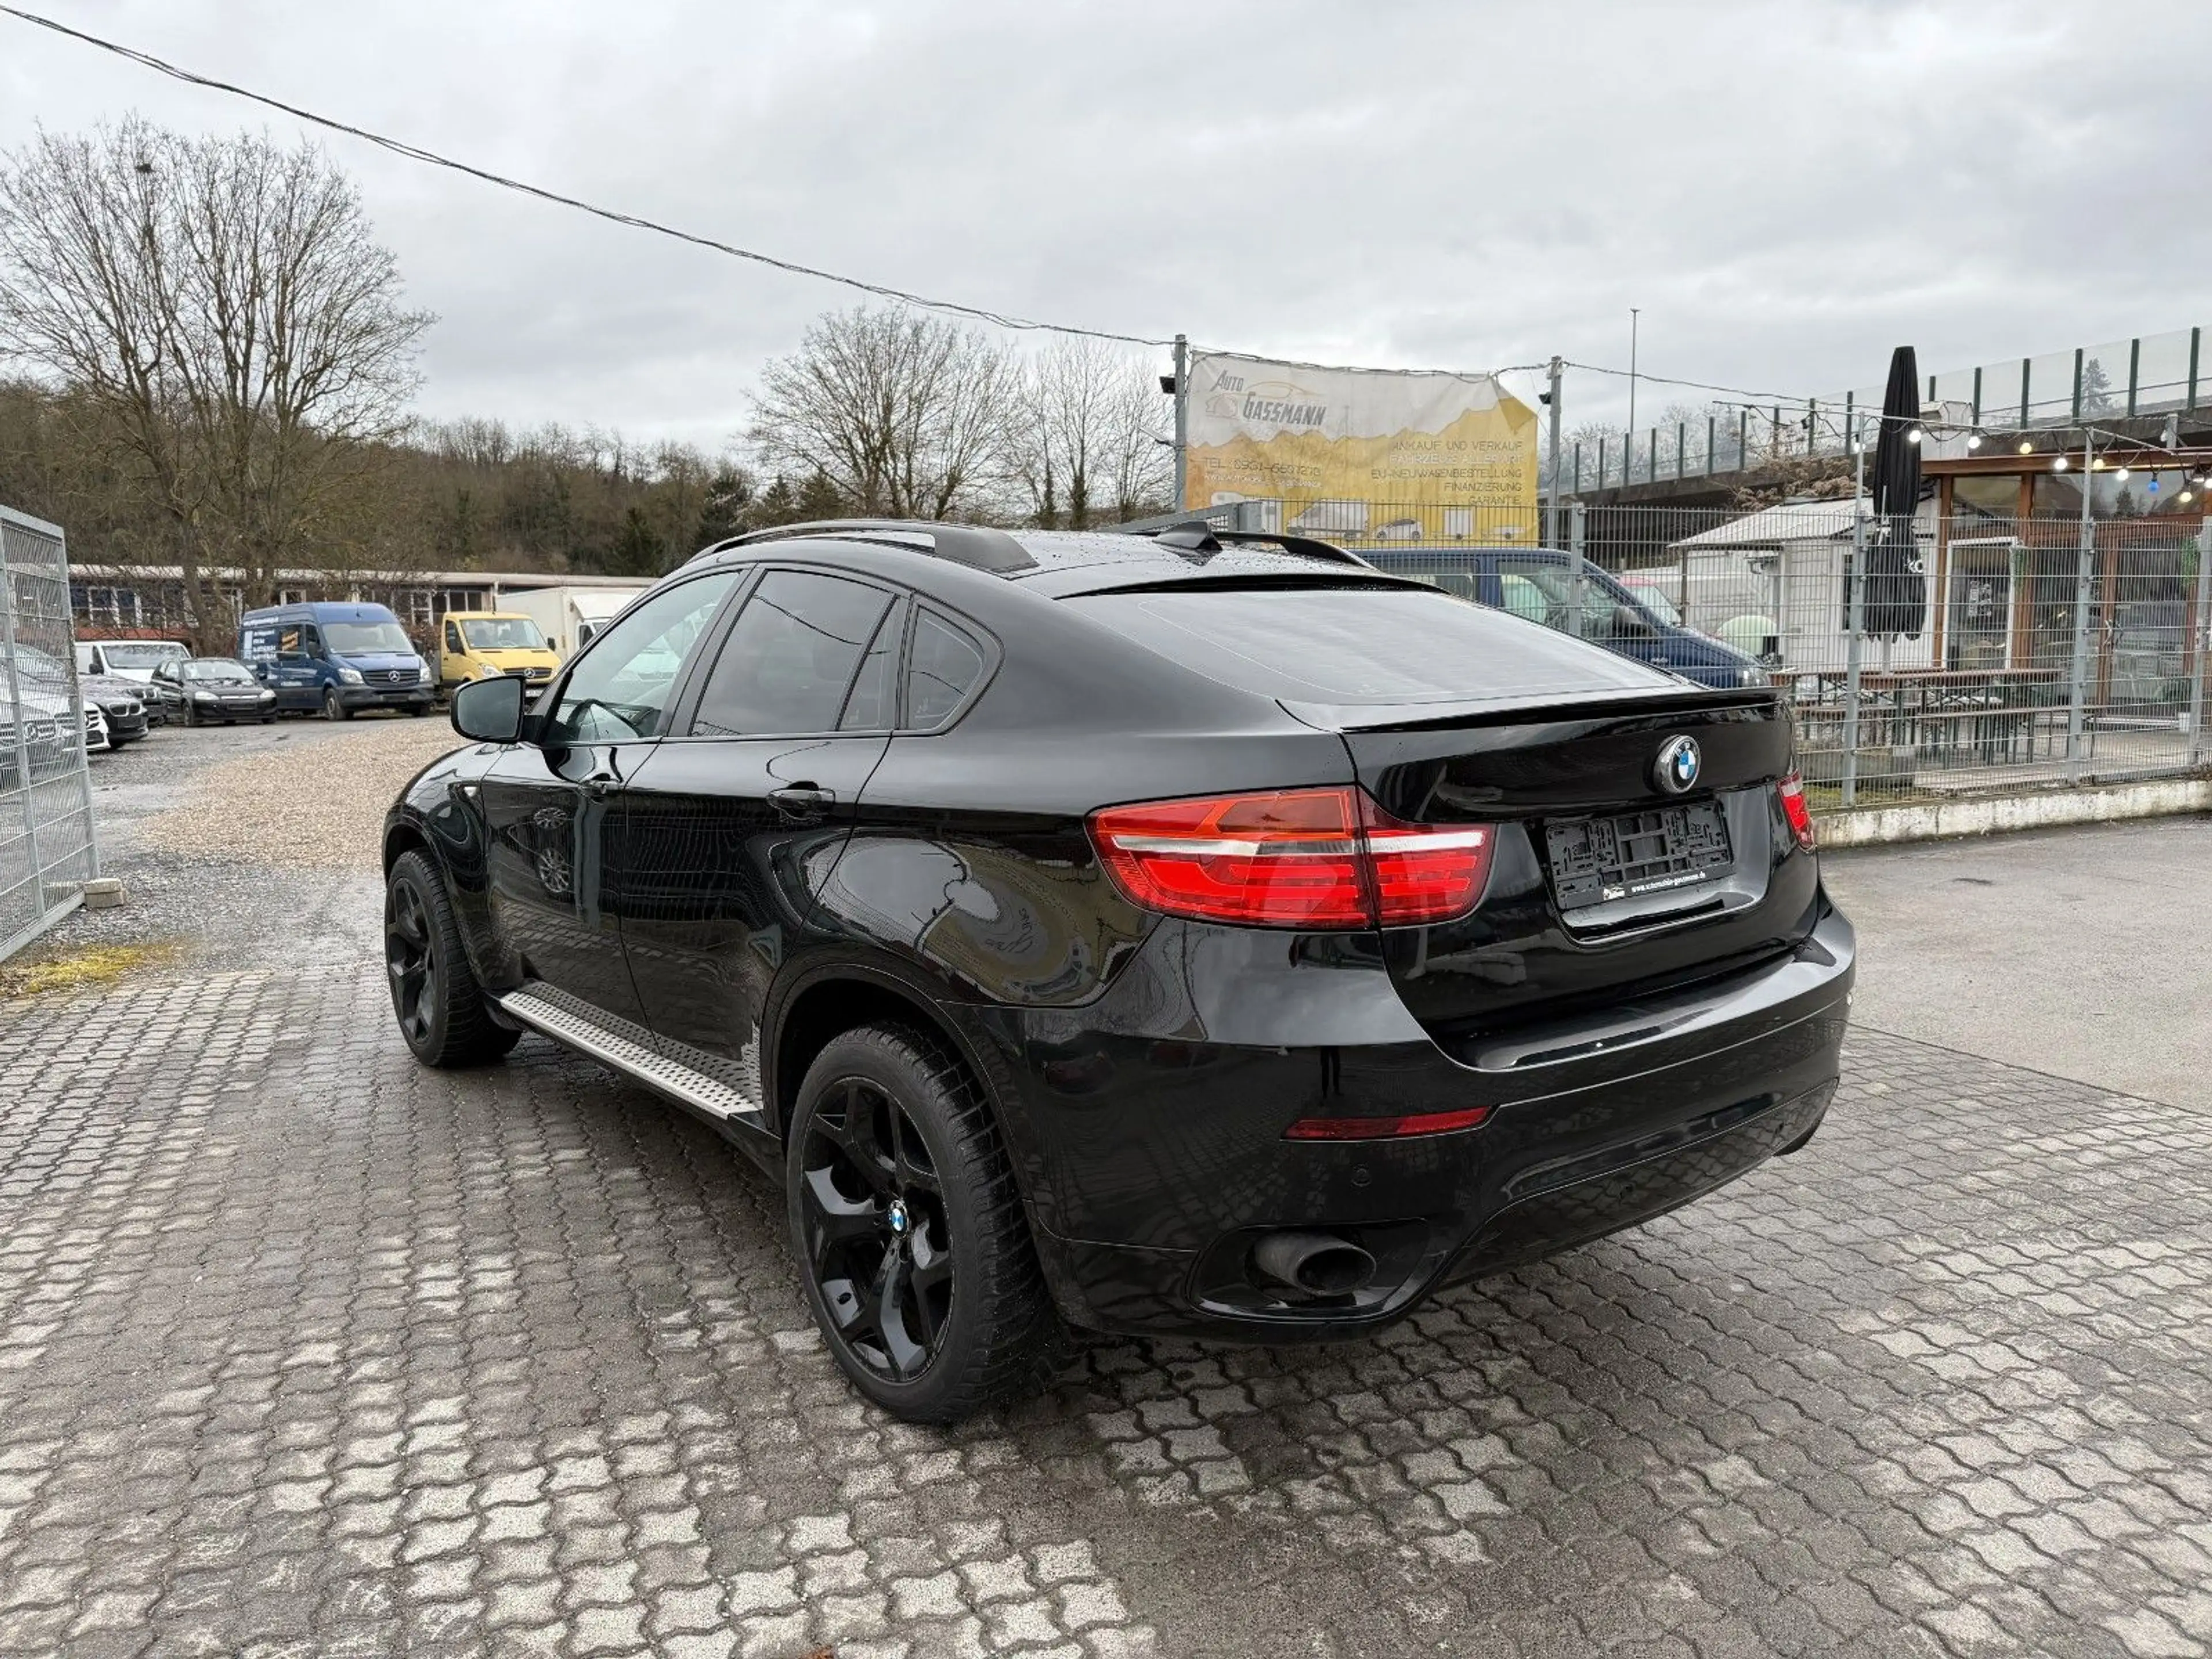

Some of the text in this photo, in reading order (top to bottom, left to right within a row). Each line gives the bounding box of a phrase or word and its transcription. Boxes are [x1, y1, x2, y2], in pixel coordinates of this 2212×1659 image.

[1210, 369, 1244, 392] AUTO
[1243, 391, 1327, 426] GASSMANN
[1392, 441, 1522, 452] ANKAUF UND VERKAUF
[1444, 482, 1522, 491] FINANZIERUNG
